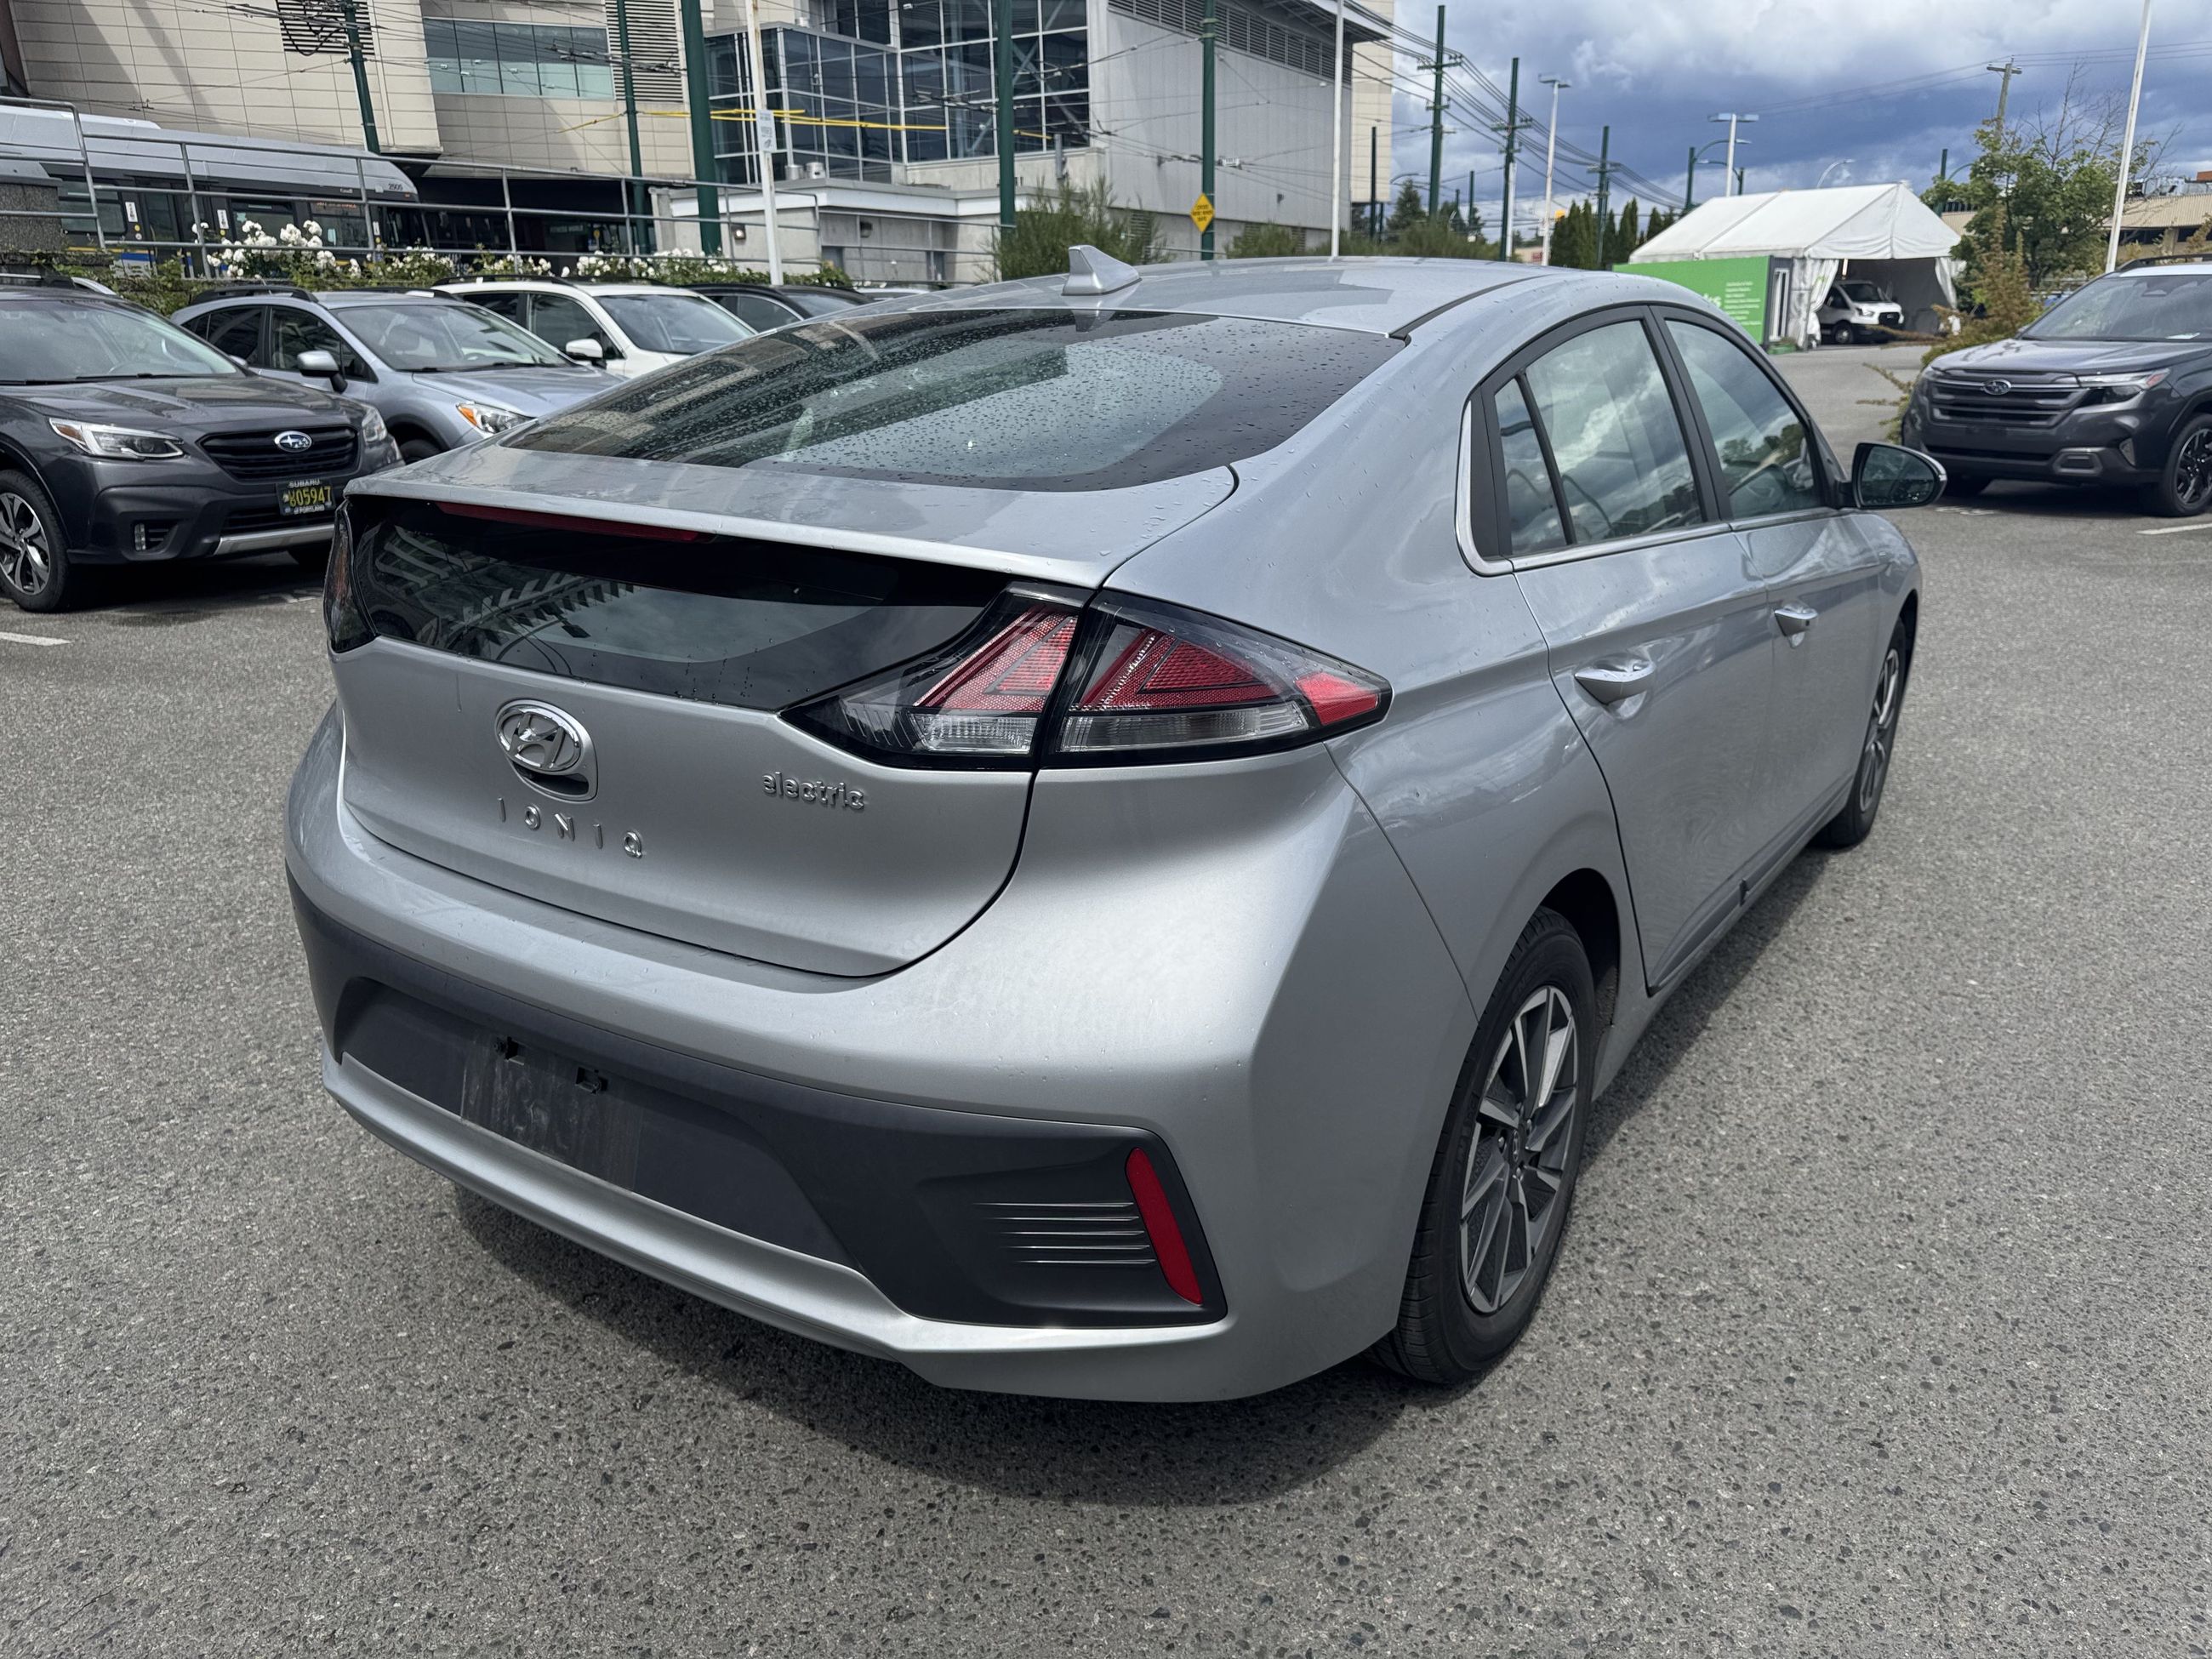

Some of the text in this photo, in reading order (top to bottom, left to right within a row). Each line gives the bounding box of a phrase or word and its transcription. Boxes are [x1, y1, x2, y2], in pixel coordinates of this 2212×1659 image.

[288, 478, 321, 488] SUBARU
[762, 772, 865, 810] electric
[498, 797, 643, 859] IONIQ
